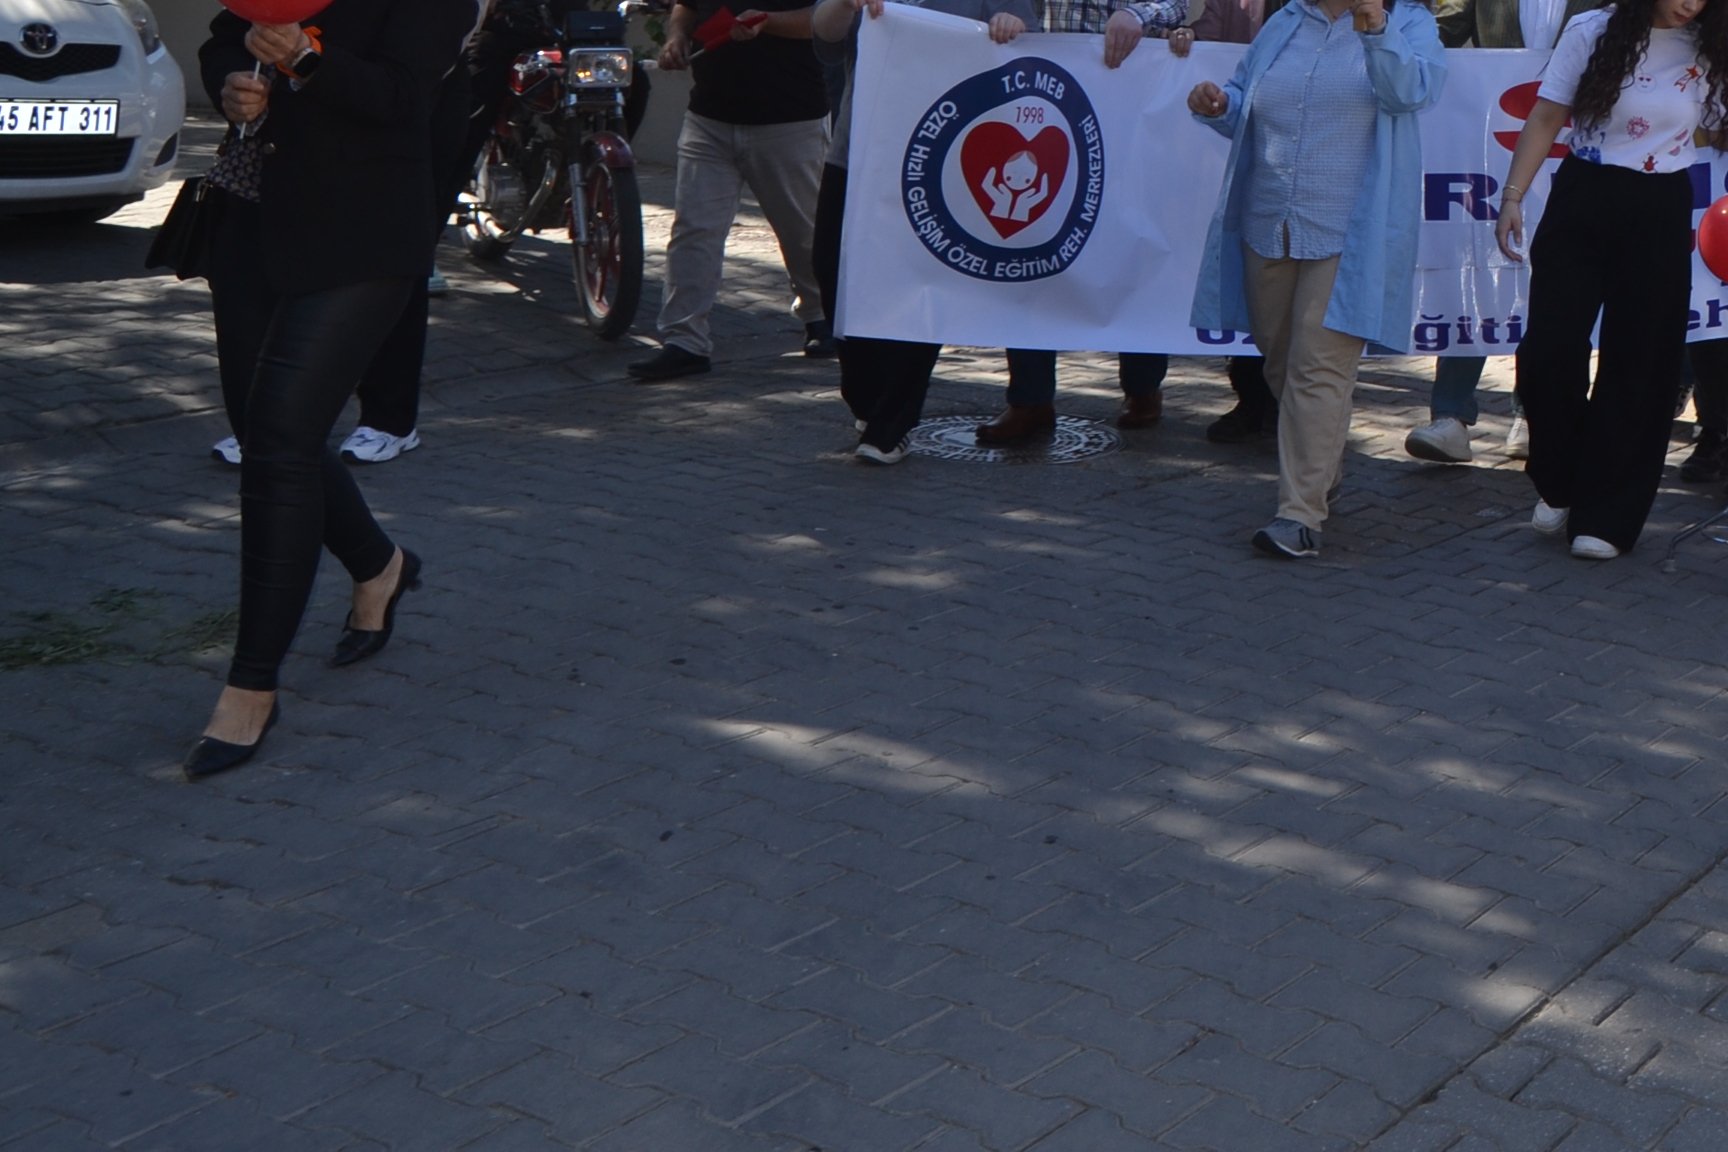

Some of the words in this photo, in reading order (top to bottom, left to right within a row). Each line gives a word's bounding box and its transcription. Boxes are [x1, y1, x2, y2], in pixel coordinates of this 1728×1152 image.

[1001, 70, 1030, 94] T.C.
[1034, 70, 1065, 100] MEB
[28, 105, 69, 131] AFT
[79, 106, 112, 131] 311
[917, 100, 960, 140] ÖZEL
[1015, 106, 1044, 124] 1998
[1078, 114, 1102, 223] MERKEZLERİ
[907, 186, 951, 253] GELİŞİM
[947, 243, 988, 276] ÖZEL
[1058, 226, 1088, 263] REH.
[994, 254, 1060, 278] EĞİTİM
